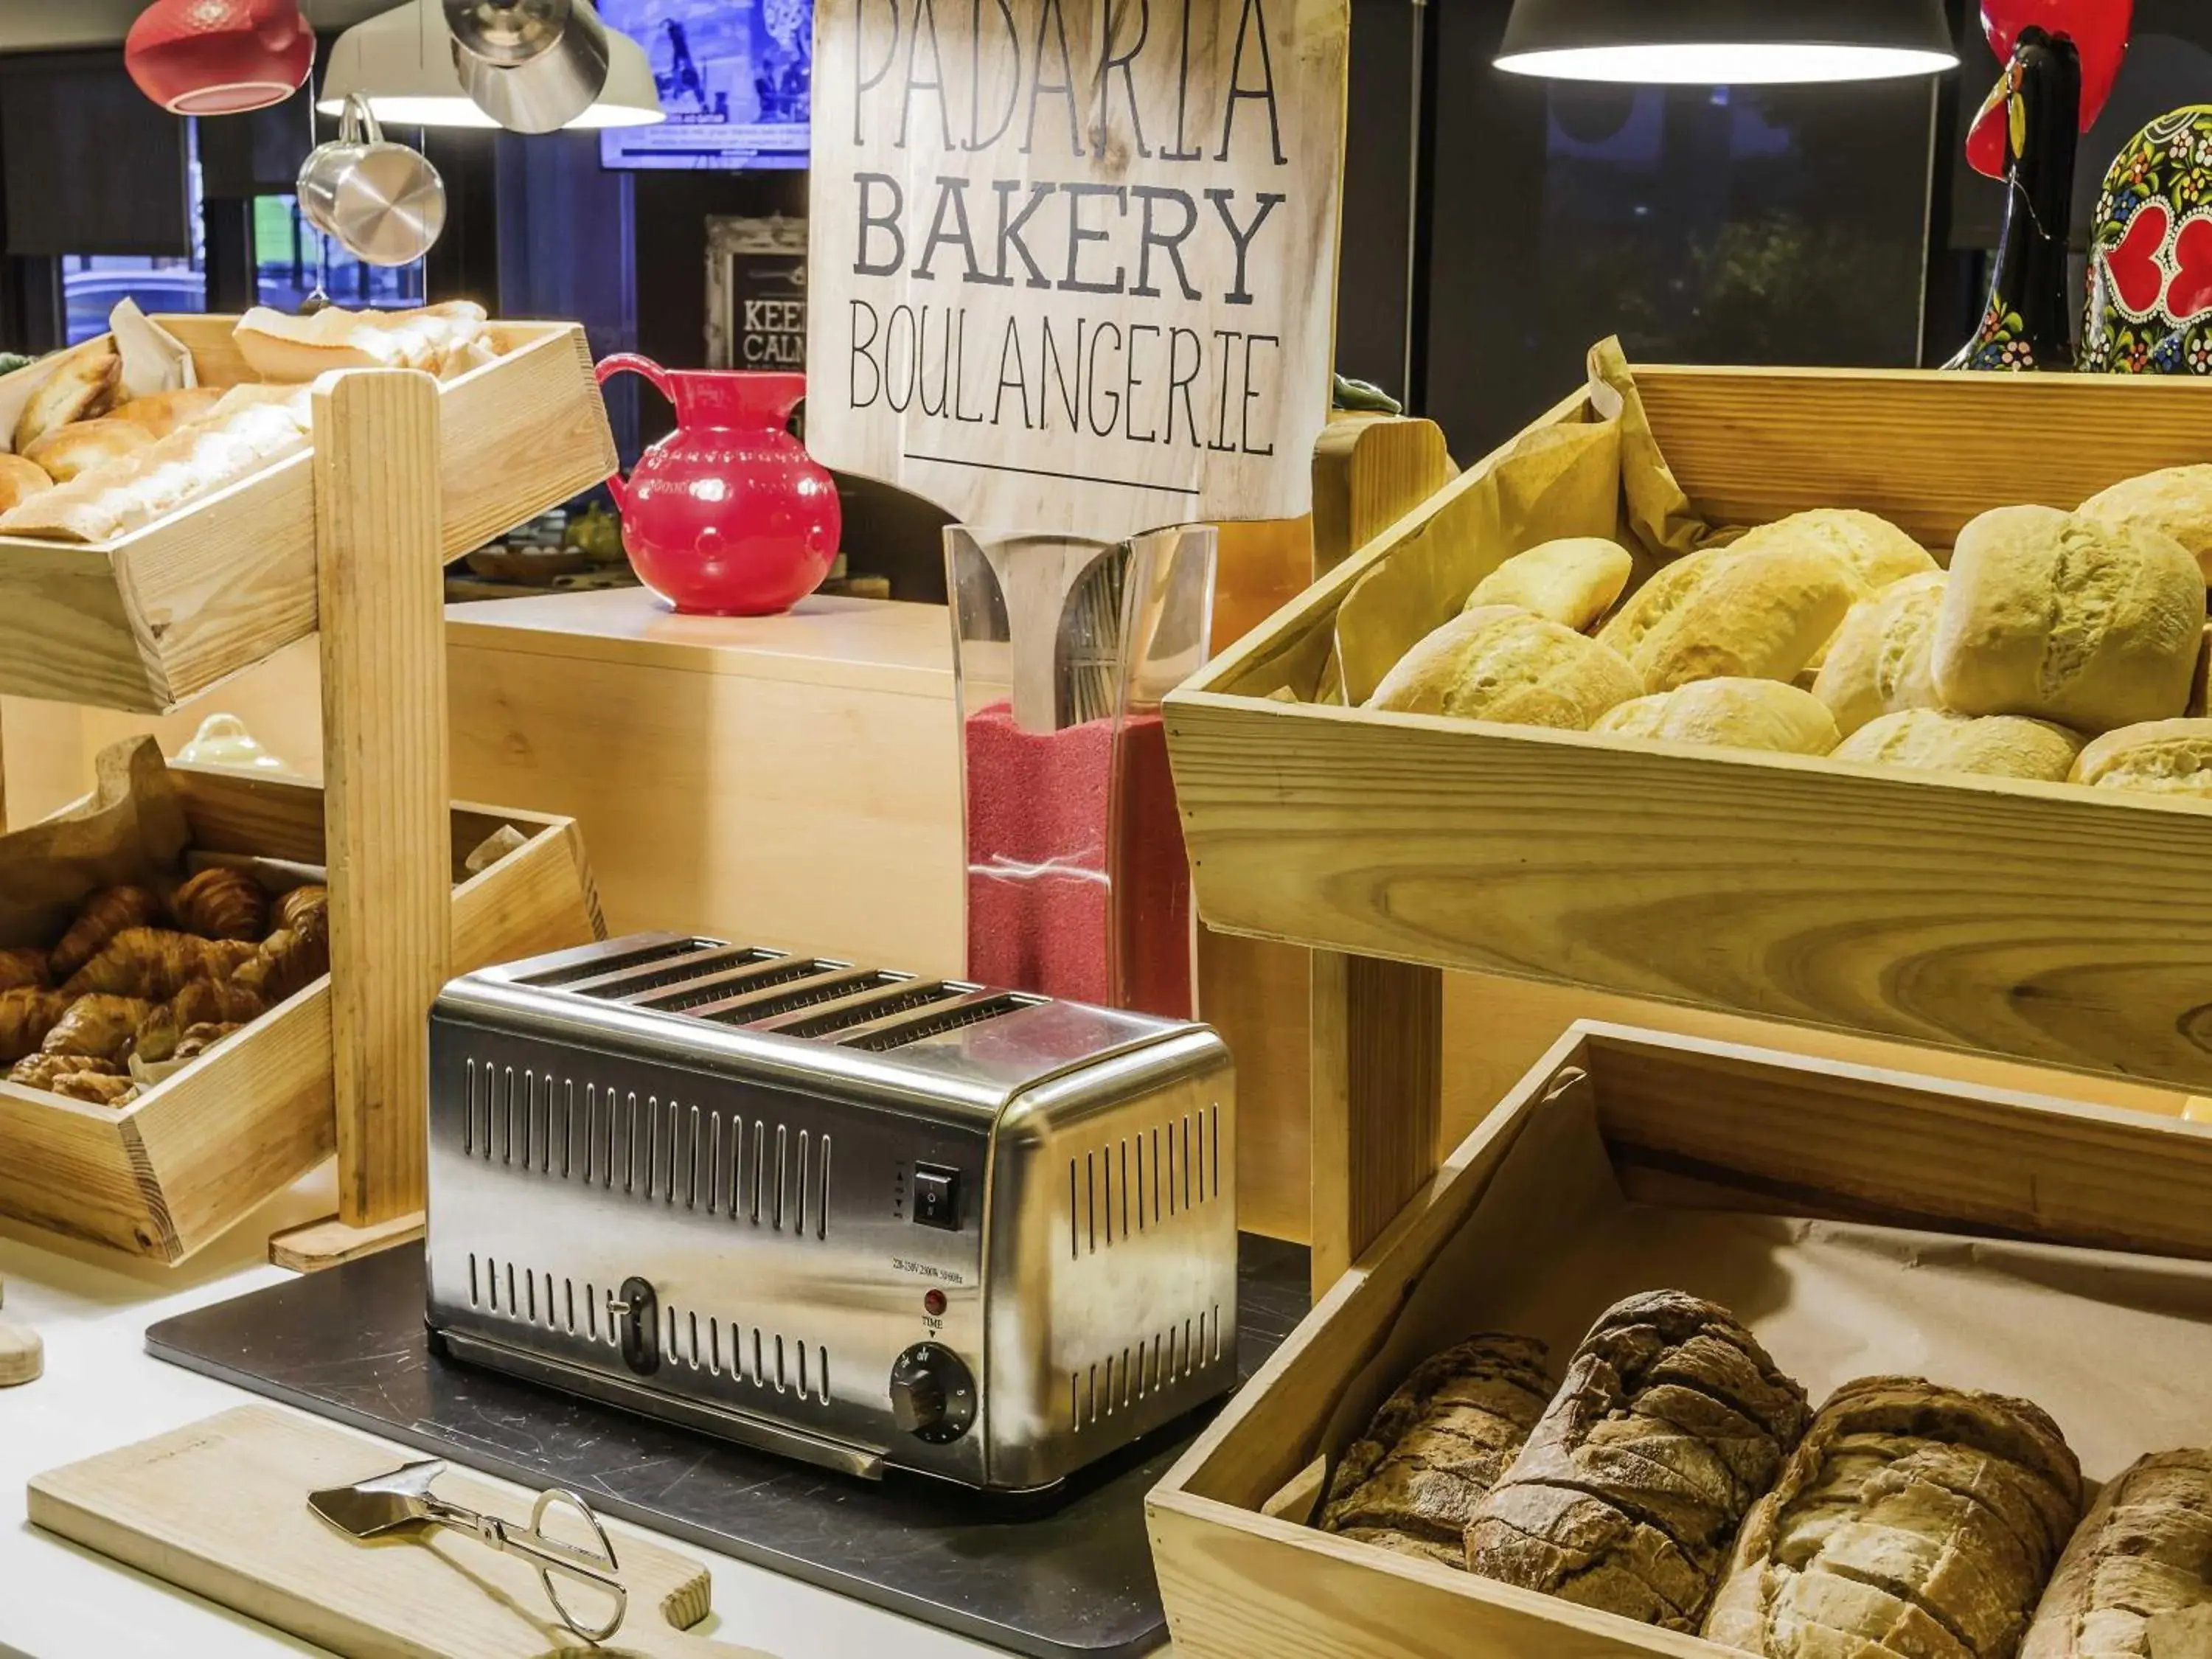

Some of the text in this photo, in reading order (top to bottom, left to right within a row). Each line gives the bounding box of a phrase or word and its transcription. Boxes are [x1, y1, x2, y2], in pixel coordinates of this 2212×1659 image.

[855, 0, 1288, 165] PADARIA
[852, 172, 1286, 305] BAKERY
[743, 300, 807, 331] KEE
[849, 299, 1279, 456] BOULANGERIE
[922, 1315, 943, 1329] TIME
